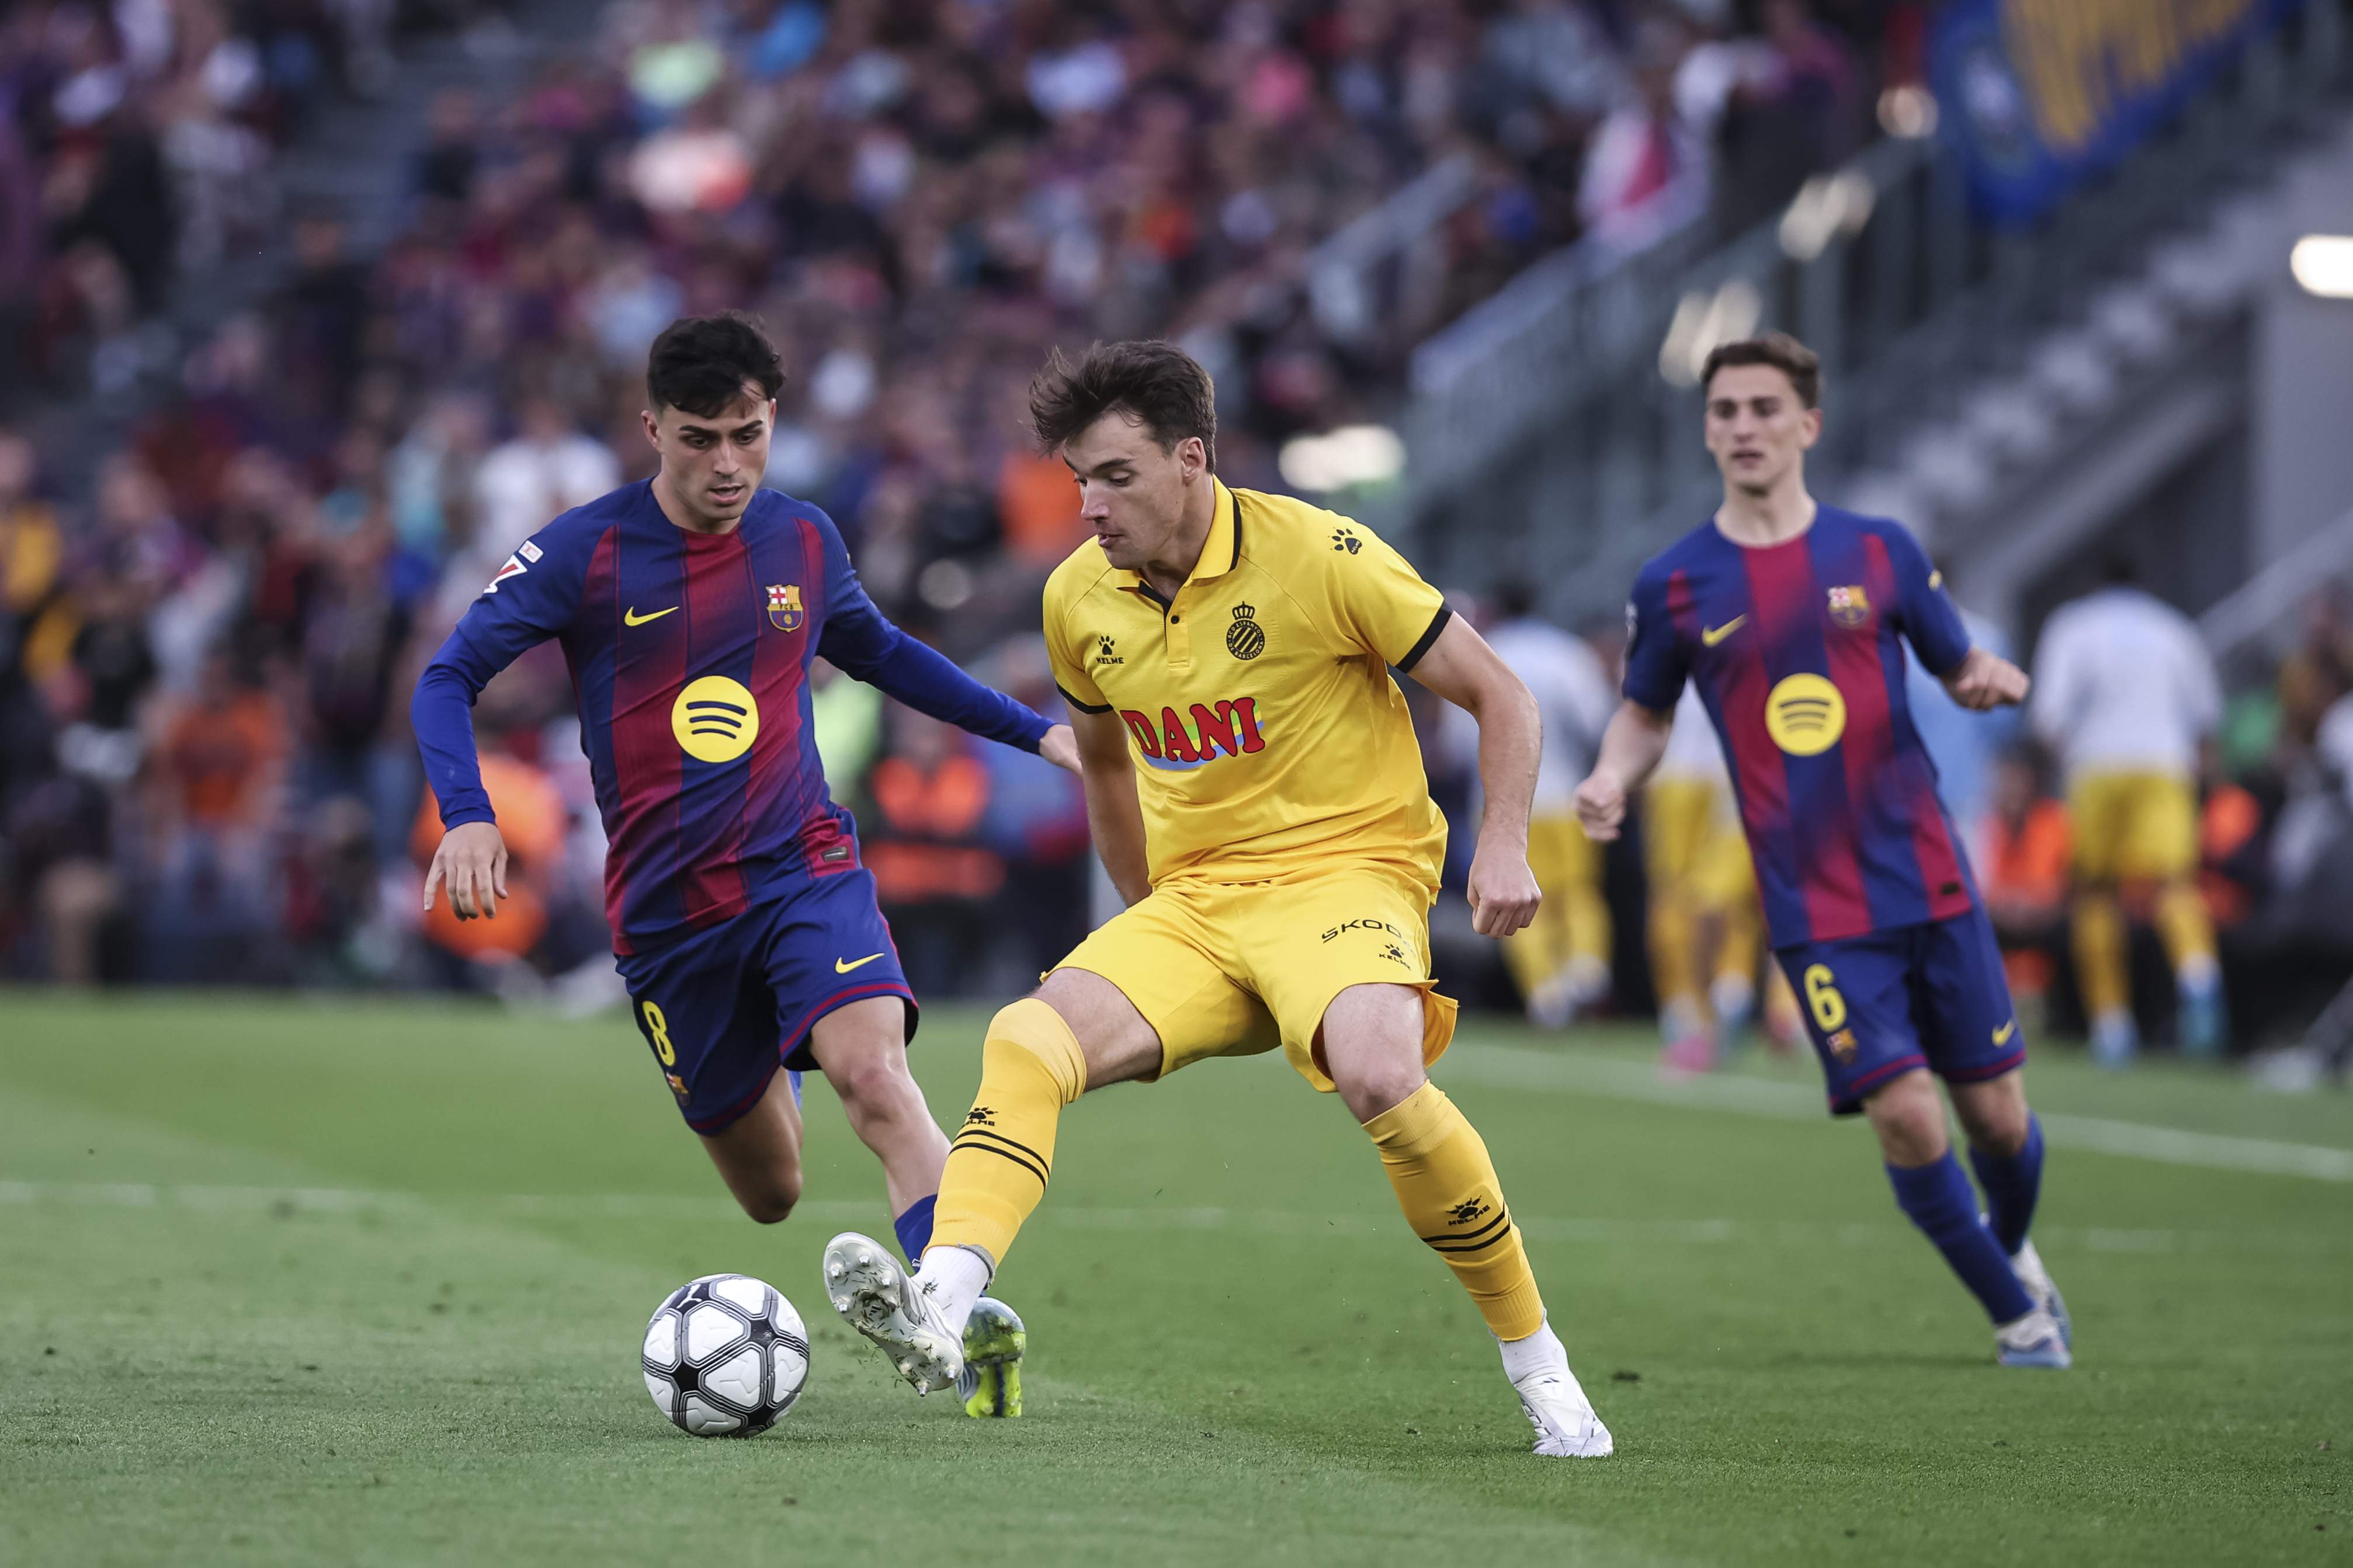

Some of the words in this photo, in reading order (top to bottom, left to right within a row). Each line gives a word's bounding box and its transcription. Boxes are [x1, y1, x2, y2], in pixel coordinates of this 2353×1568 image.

[1234, 641, 1264, 659] BARCELONA
[1119, 697, 1265, 762] DANI
[1321, 919, 1407, 944] SKOD
[1804, 963, 1847, 1032] 6
[643, 1000, 676, 1066] 8
[1448, 1205, 1491, 1226] KELME
